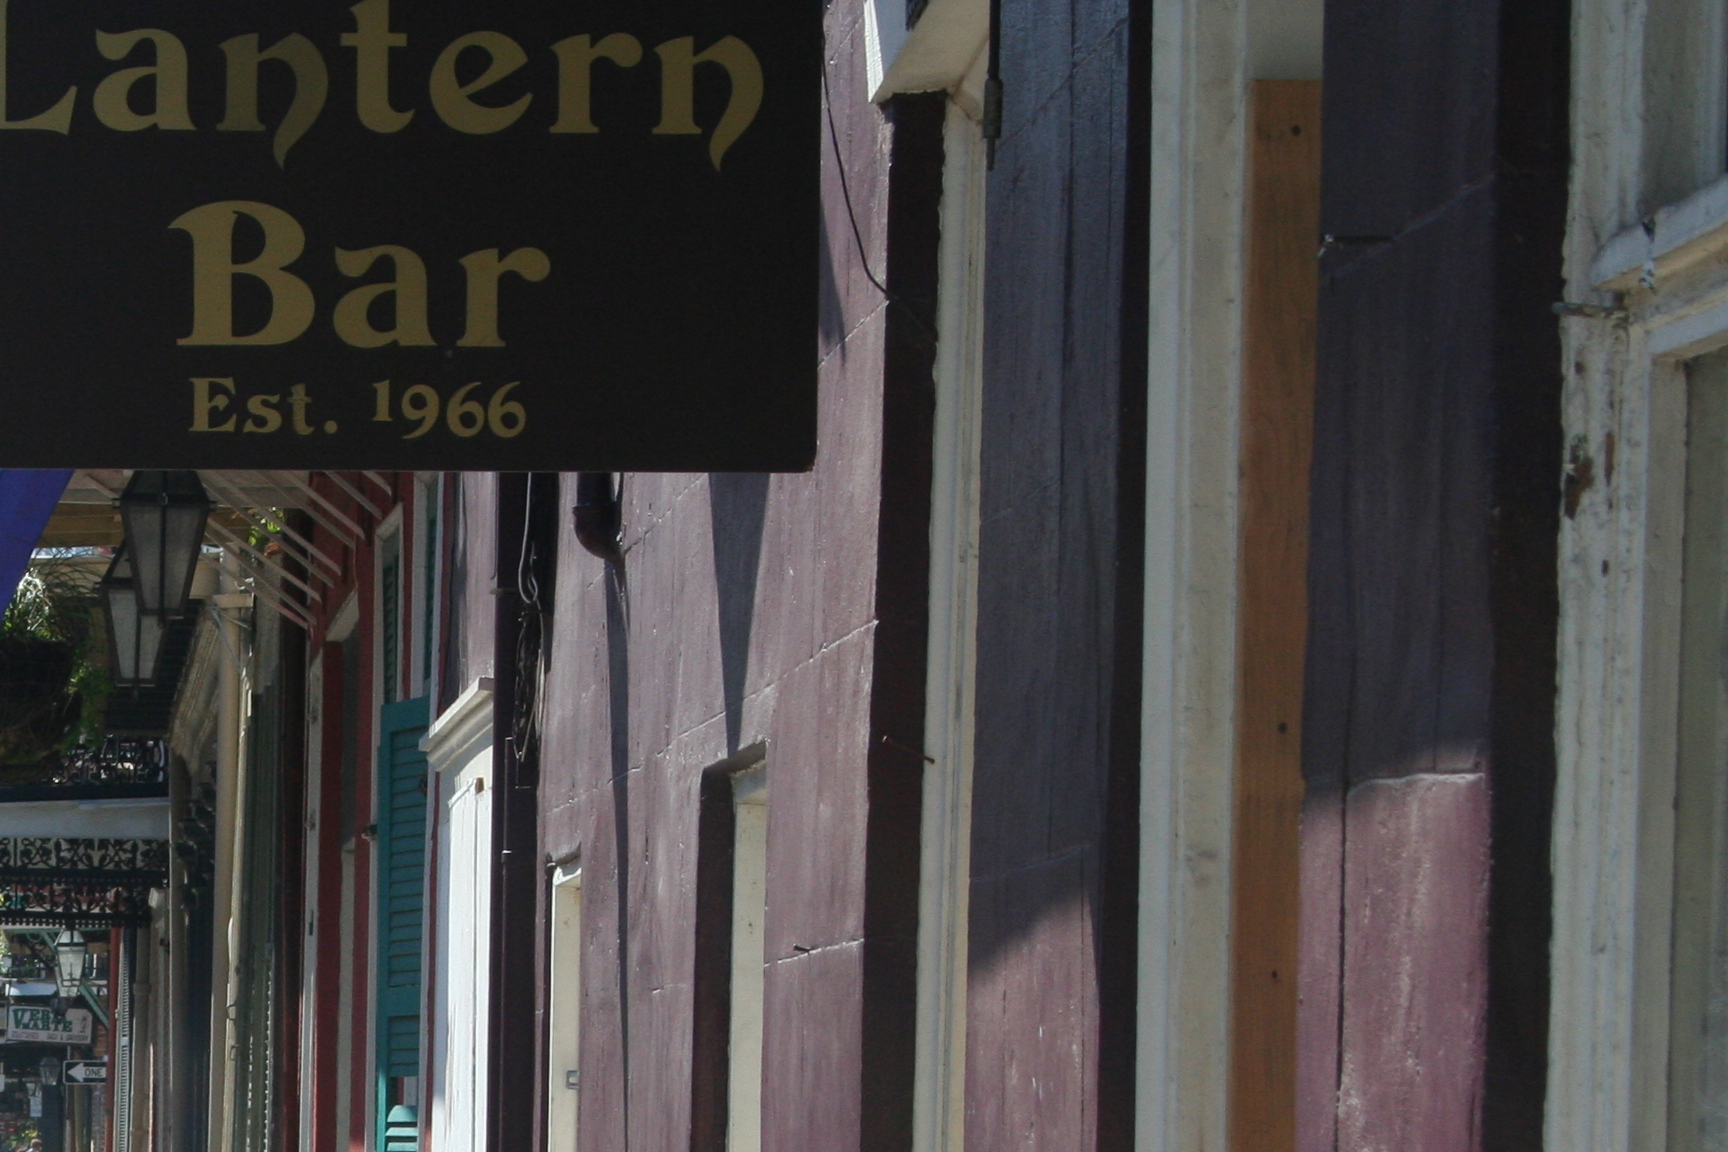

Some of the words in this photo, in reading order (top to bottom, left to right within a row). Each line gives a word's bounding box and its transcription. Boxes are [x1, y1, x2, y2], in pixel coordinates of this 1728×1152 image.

[167, 200, 551, 348] Bar
[189, 377, 338, 436] Est.
[373, 380, 527, 439] 1966
[84, 1067, 103, 1077] ONE
